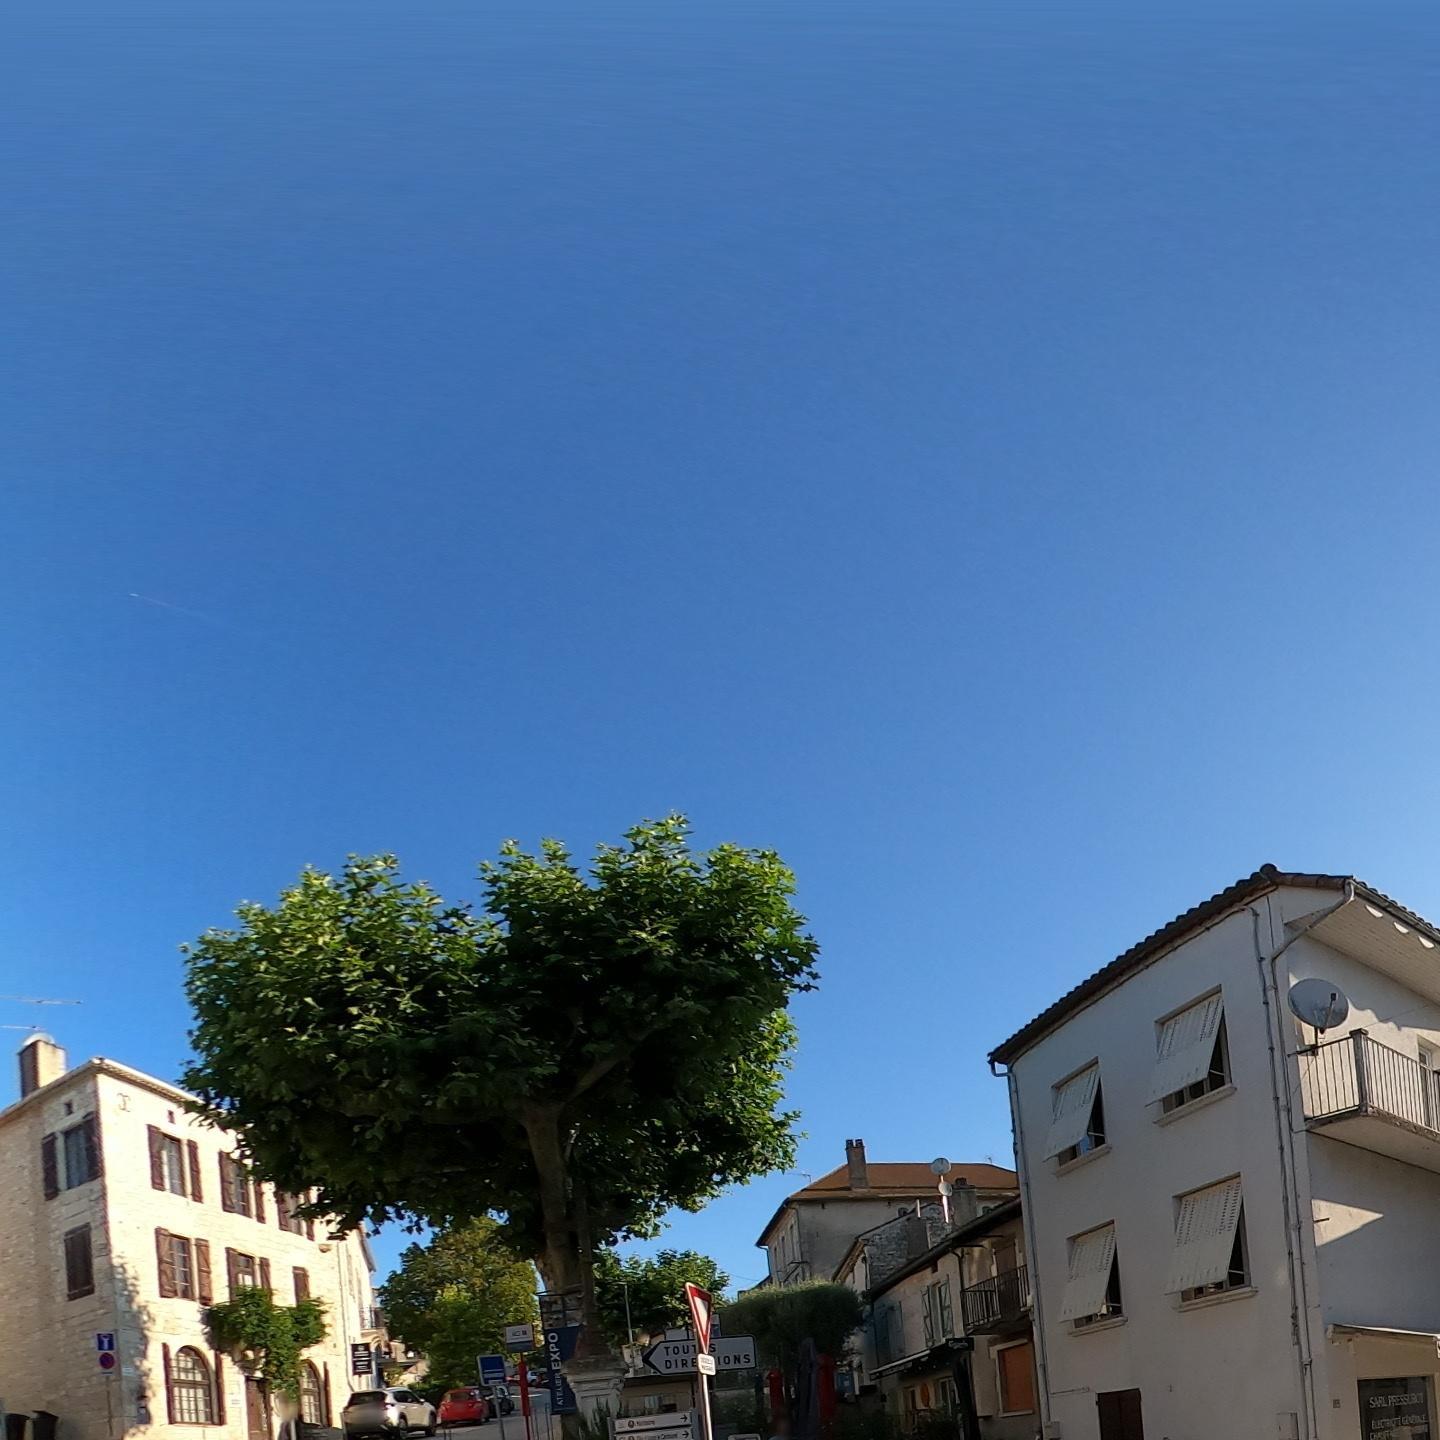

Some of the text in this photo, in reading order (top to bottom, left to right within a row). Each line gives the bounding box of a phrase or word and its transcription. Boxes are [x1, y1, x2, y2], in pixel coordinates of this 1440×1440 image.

[547, 1332, 562, 1370] EXPO
[663, 1343, 717, 1357] TOUTS
[664, 1353, 751, 1369] DIREIONS
